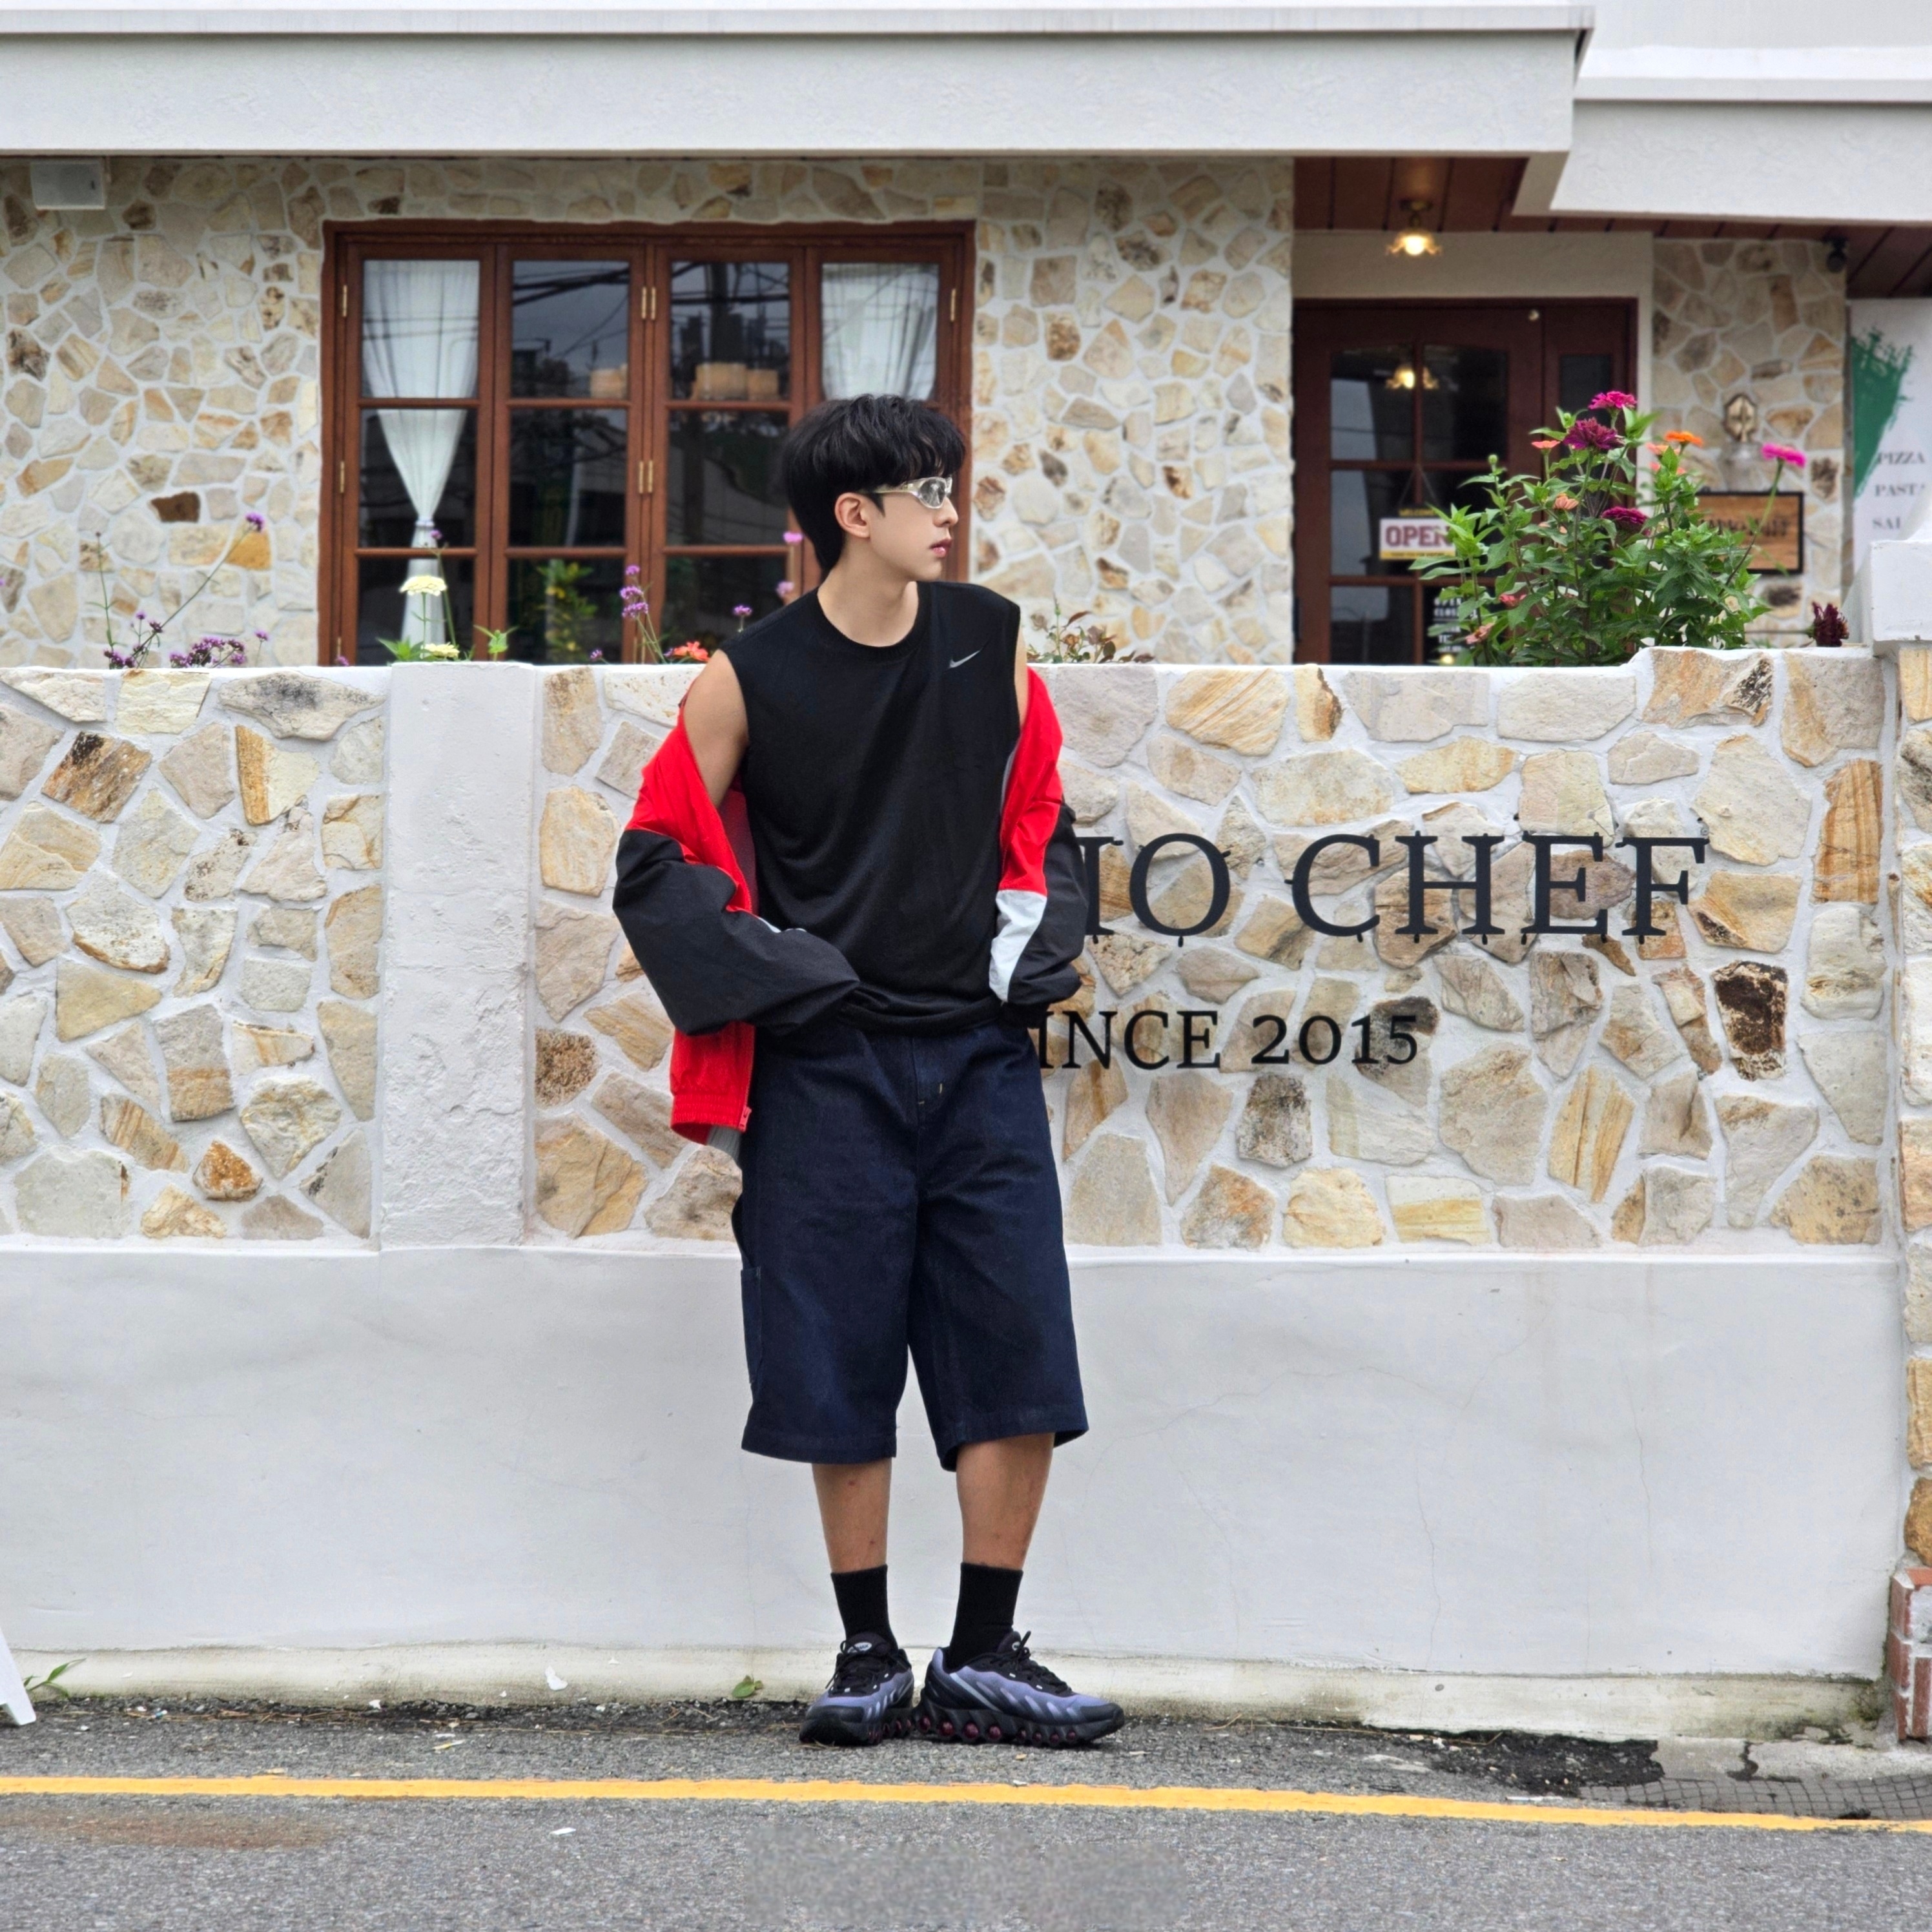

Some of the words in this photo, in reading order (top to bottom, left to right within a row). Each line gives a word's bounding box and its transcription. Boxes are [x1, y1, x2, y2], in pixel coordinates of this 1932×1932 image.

[1877, 451, 1926, 464] PIZZA
[1290, 833, 1710, 937] CHEF
[1250, 1014, 1417, 1065] 2015
